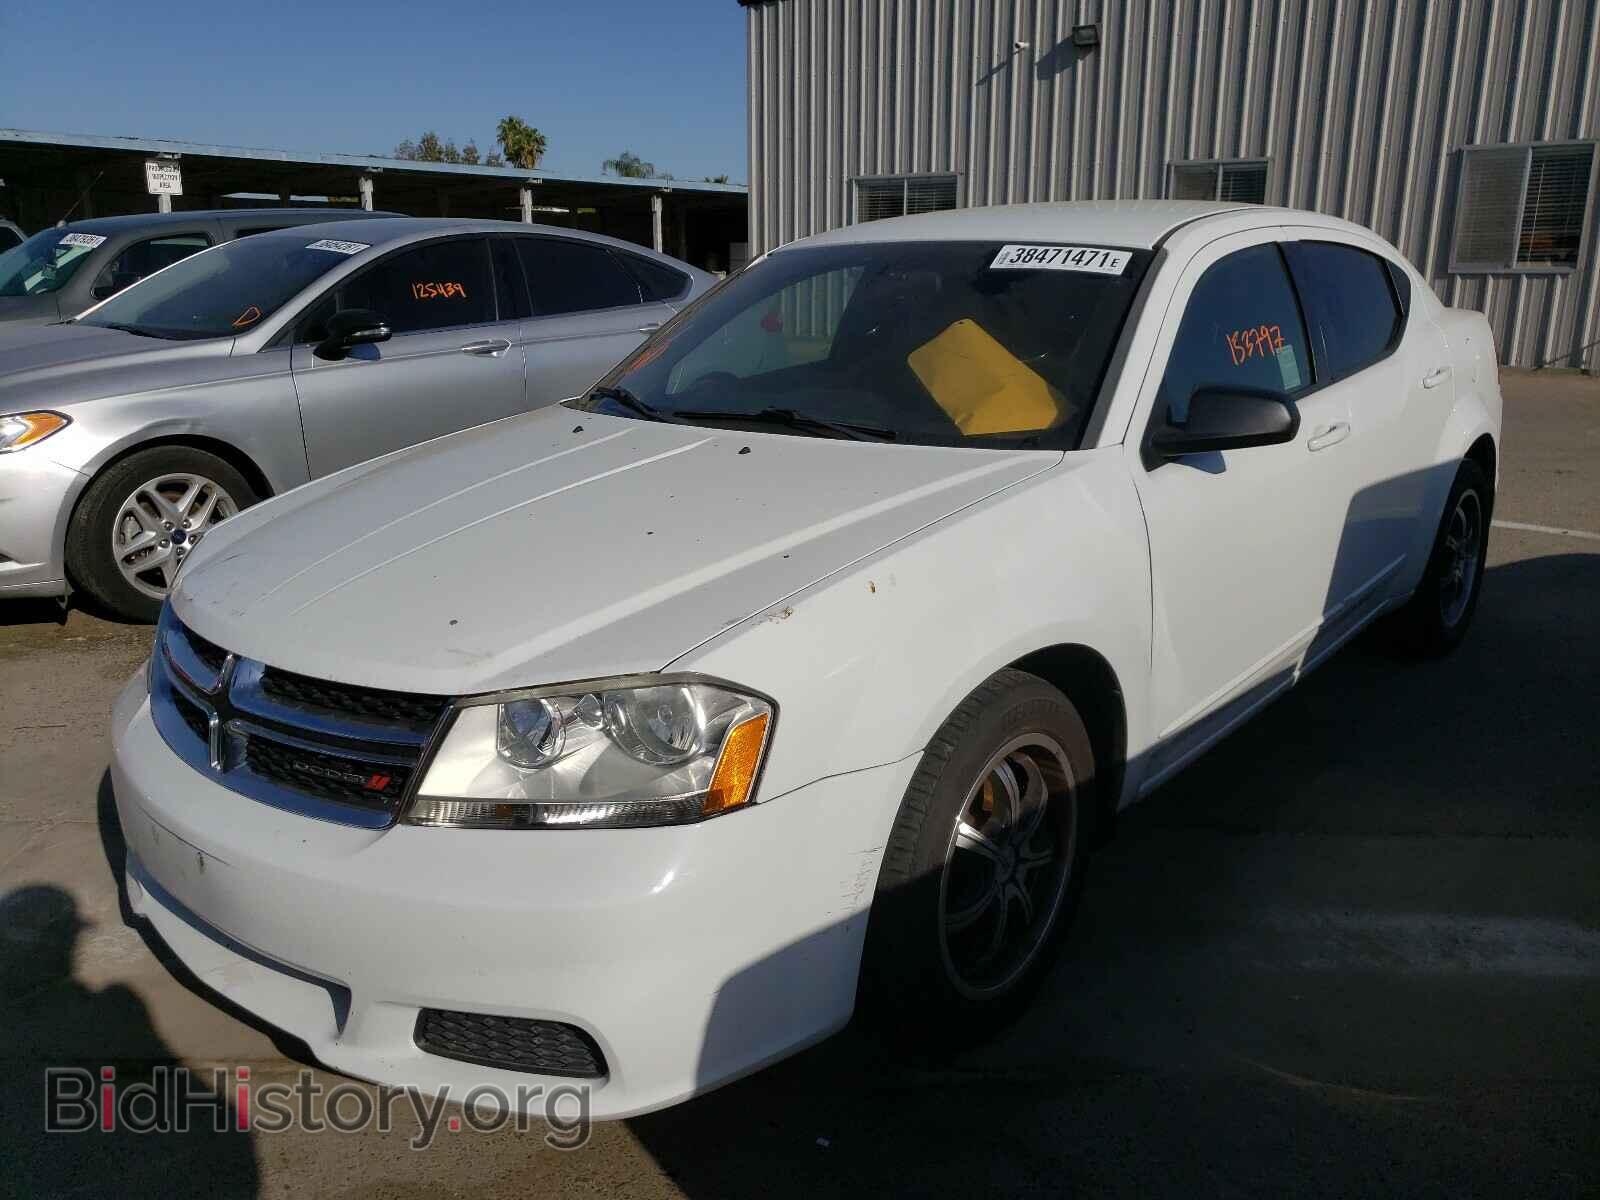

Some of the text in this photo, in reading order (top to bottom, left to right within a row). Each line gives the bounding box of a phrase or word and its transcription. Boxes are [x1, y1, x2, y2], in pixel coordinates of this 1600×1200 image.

[1009, 247, 1110, 267] 38471471
[1110, 258, 1121, 268] E
[411, 282, 467, 299] 125439
